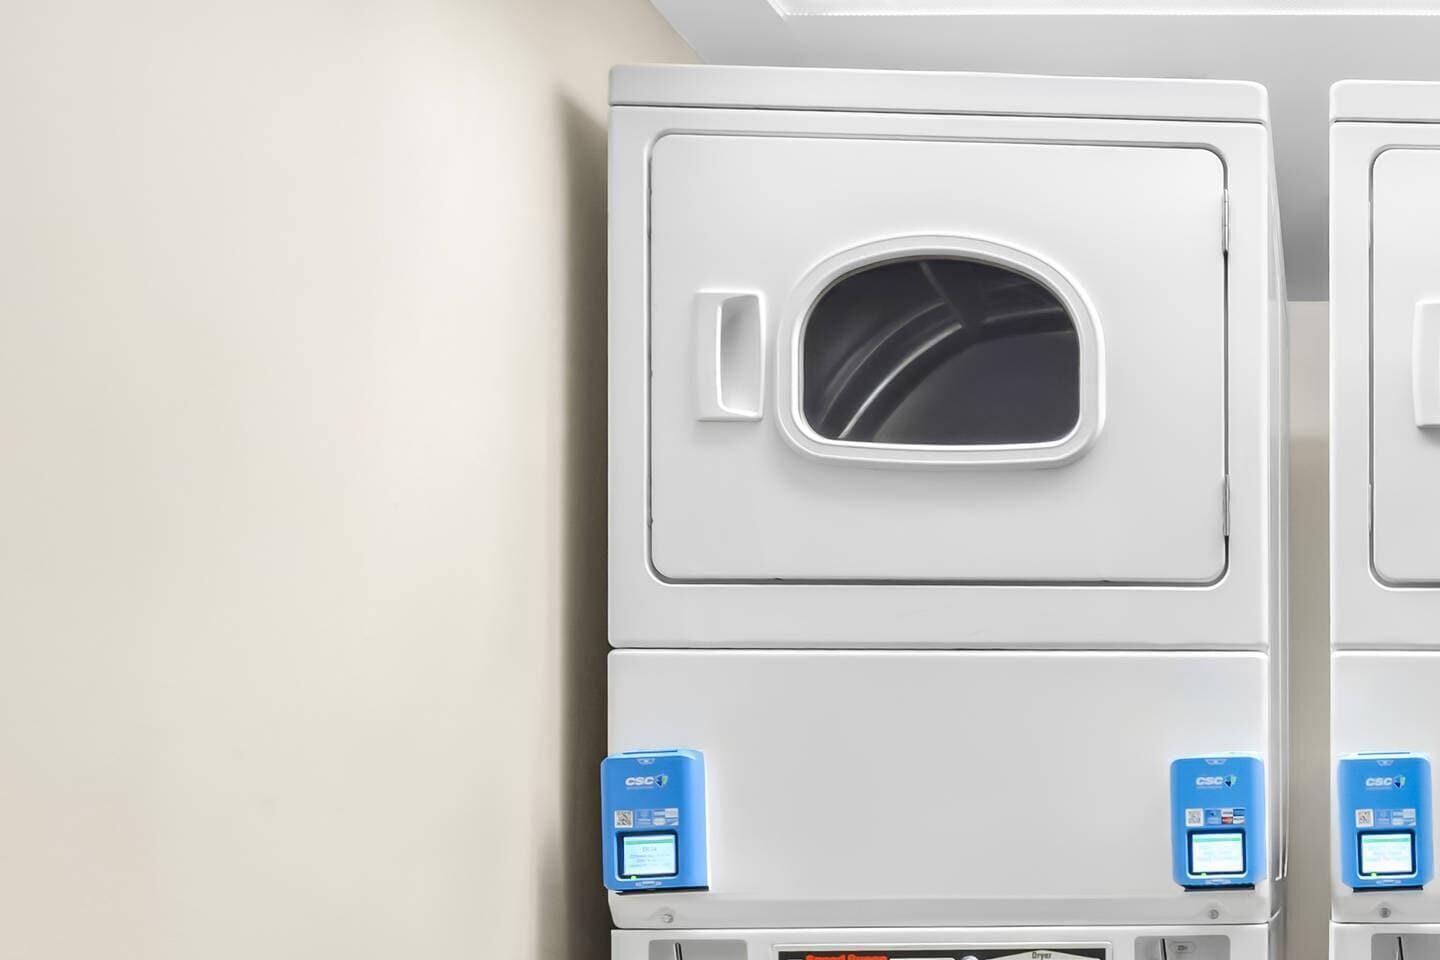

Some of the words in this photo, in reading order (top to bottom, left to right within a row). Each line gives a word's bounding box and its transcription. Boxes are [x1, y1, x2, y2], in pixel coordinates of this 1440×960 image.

[625, 776, 655, 786] CSC
[1195, 776, 1223, 786] CSC
[1365, 777, 1393, 787] CSC
[1031, 951, 1052, 960] Dryer
